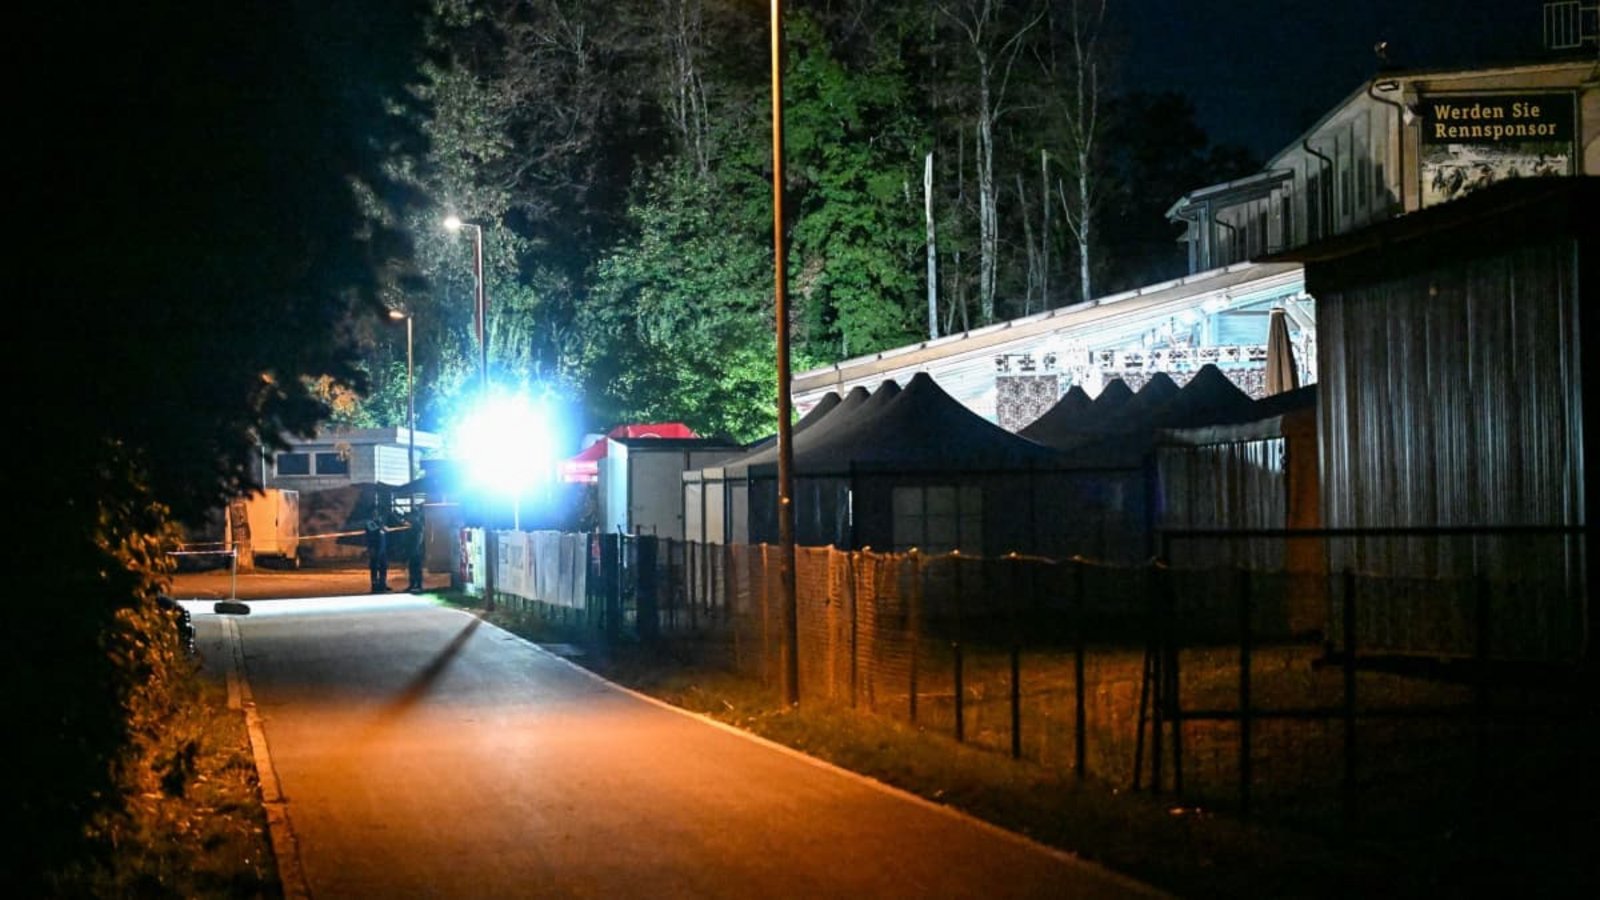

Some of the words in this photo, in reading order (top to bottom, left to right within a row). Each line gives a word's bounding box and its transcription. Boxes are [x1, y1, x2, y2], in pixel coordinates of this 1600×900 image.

[1434, 103, 1504, 120] Werden
[1512, 102, 1541, 118] Sie
[1435, 122, 1557, 140] Rennsponsor
